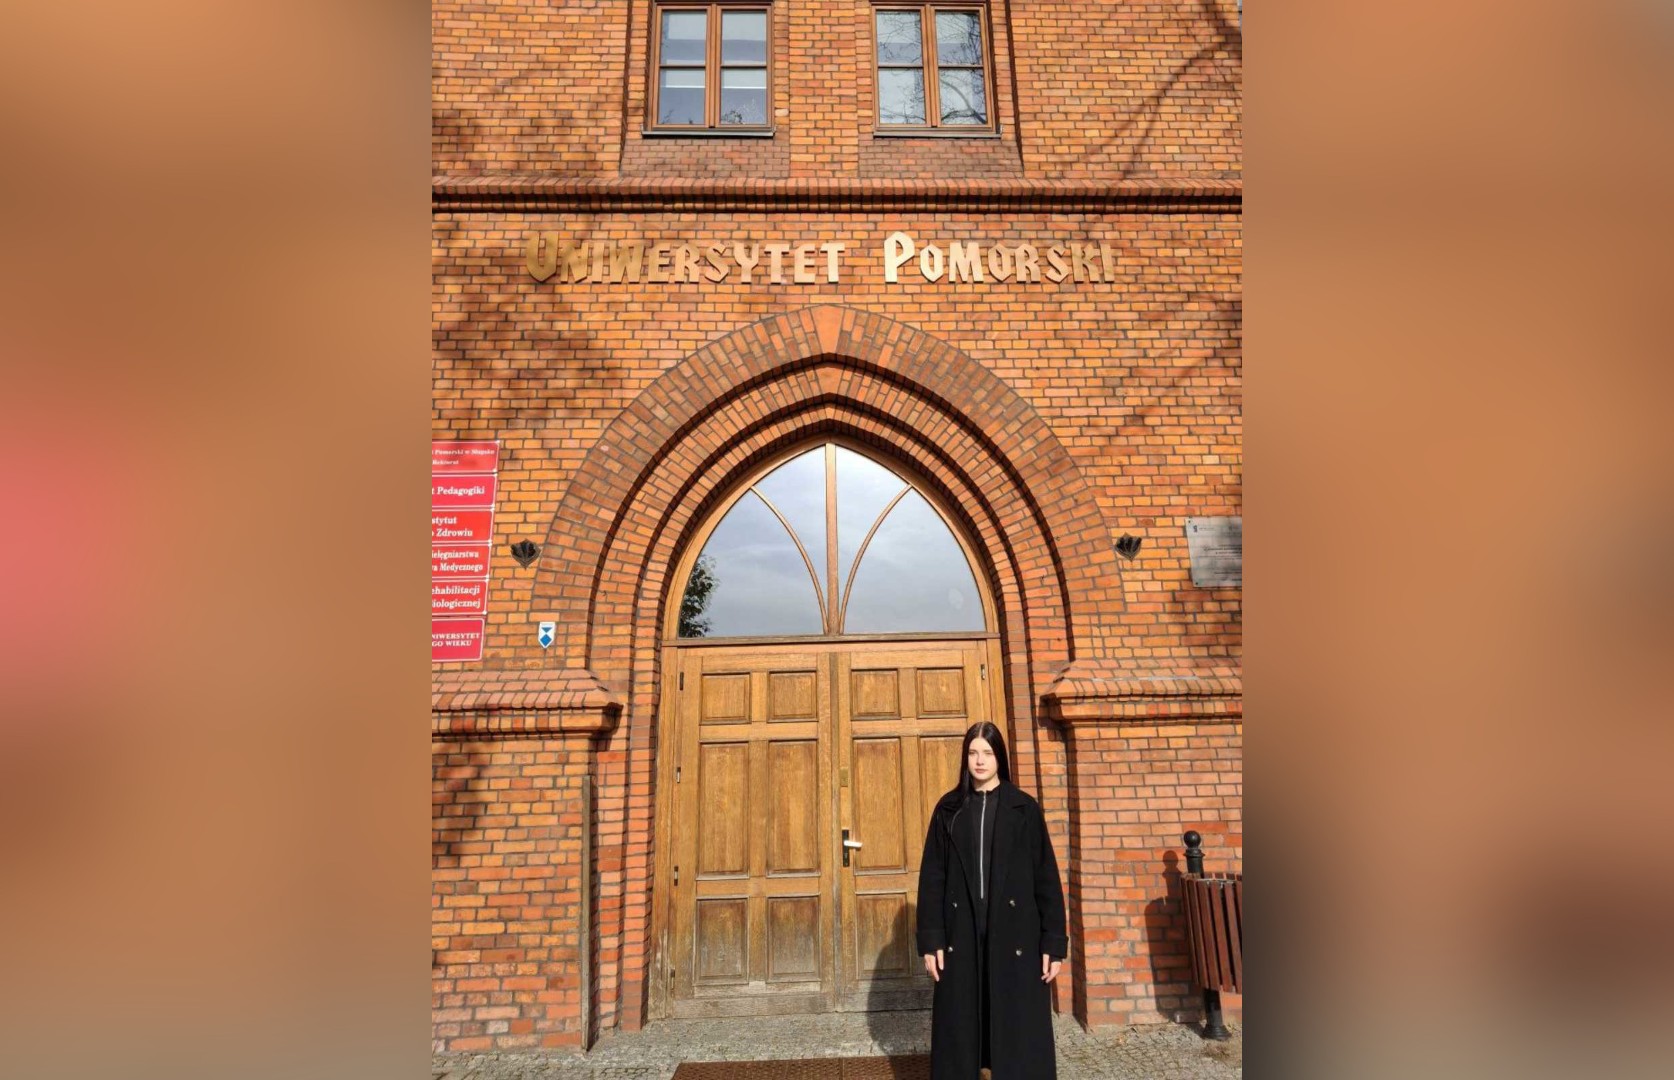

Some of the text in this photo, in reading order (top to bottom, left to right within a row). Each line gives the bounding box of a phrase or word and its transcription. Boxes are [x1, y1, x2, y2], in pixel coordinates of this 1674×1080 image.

[525, 231, 1115, 284] UNIWERSYTET POMORSKI
[437, 486, 485, 496] Pedagogiki
[436, 528, 473, 537] Zdrowiu
[439, 562, 483, 573] Medycznego
[432, 599, 480, 609] iologicznej
[445, 639, 472, 647] WIEKU
